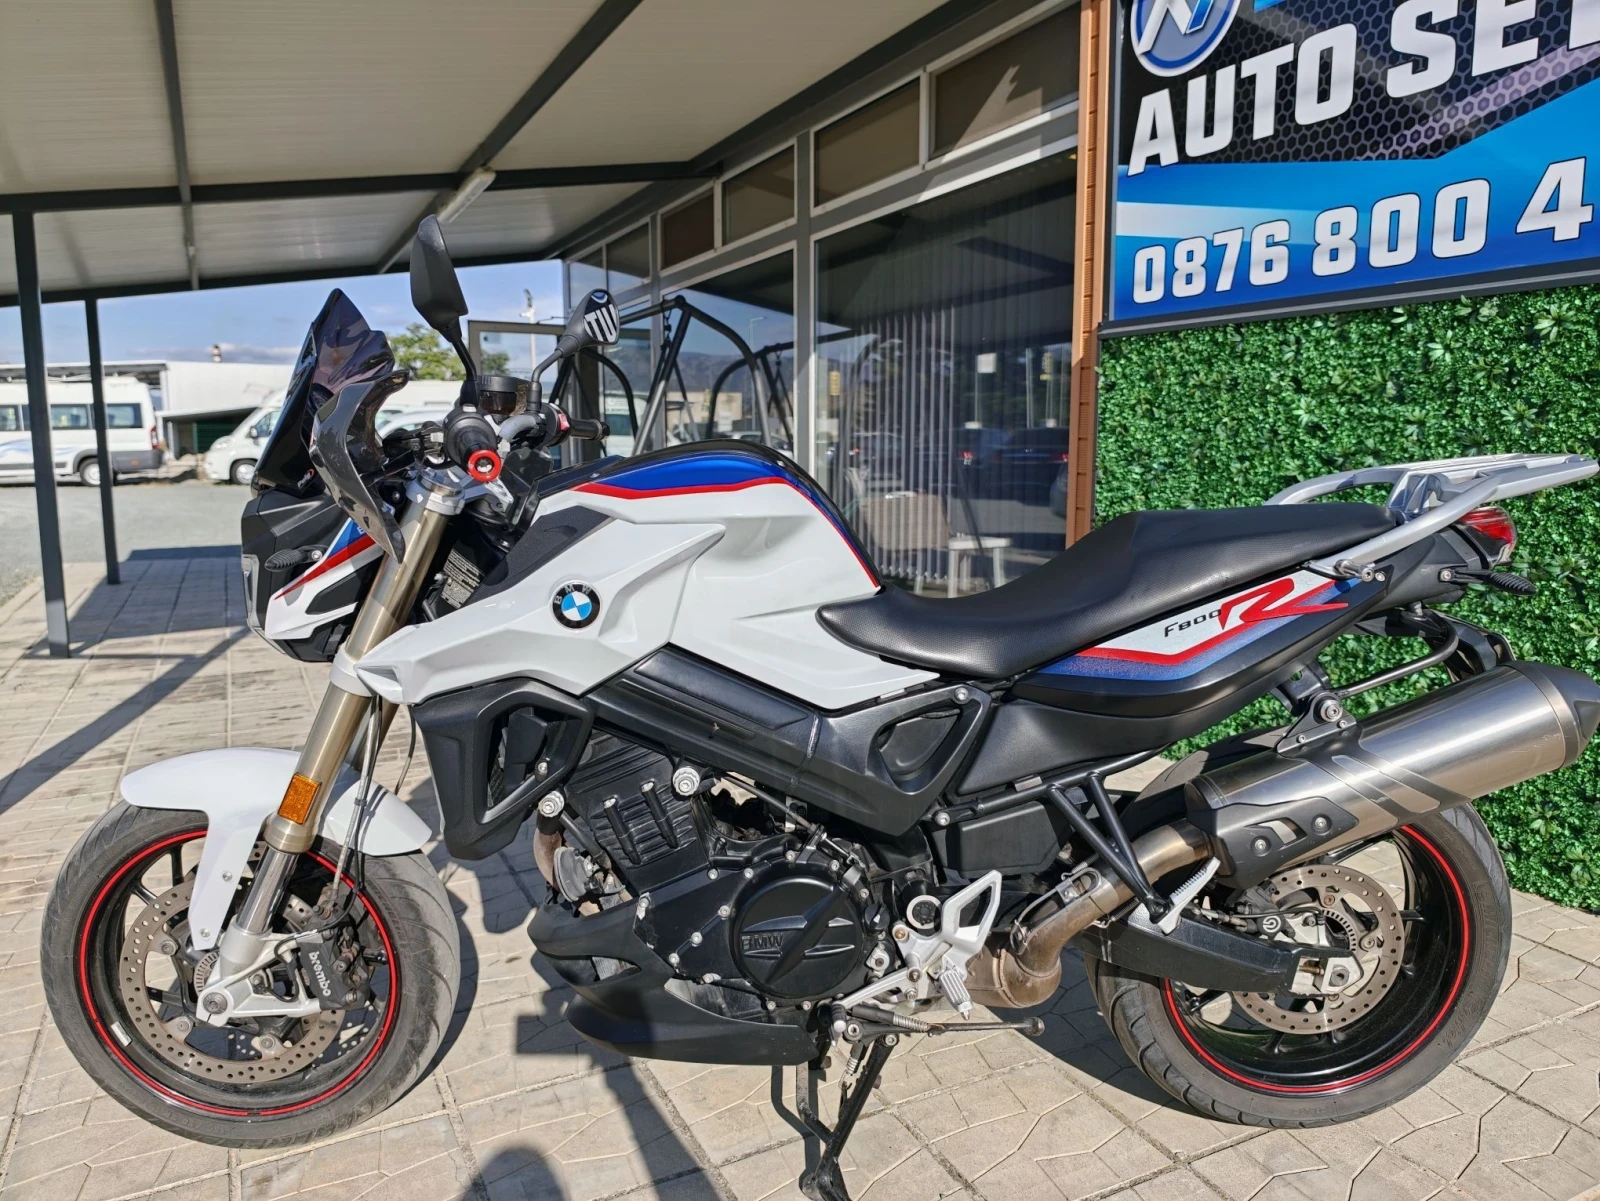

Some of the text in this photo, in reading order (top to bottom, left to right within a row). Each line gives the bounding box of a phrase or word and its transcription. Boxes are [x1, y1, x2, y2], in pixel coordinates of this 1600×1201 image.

[1126, 0, 1600, 177] AUTO SE
[1132, 156, 1594, 304] 0876 800 4
[553, 583, 593, 605] BMW
[741, 933, 783, 951] BMW
[308, 950, 332, 997] brembo
